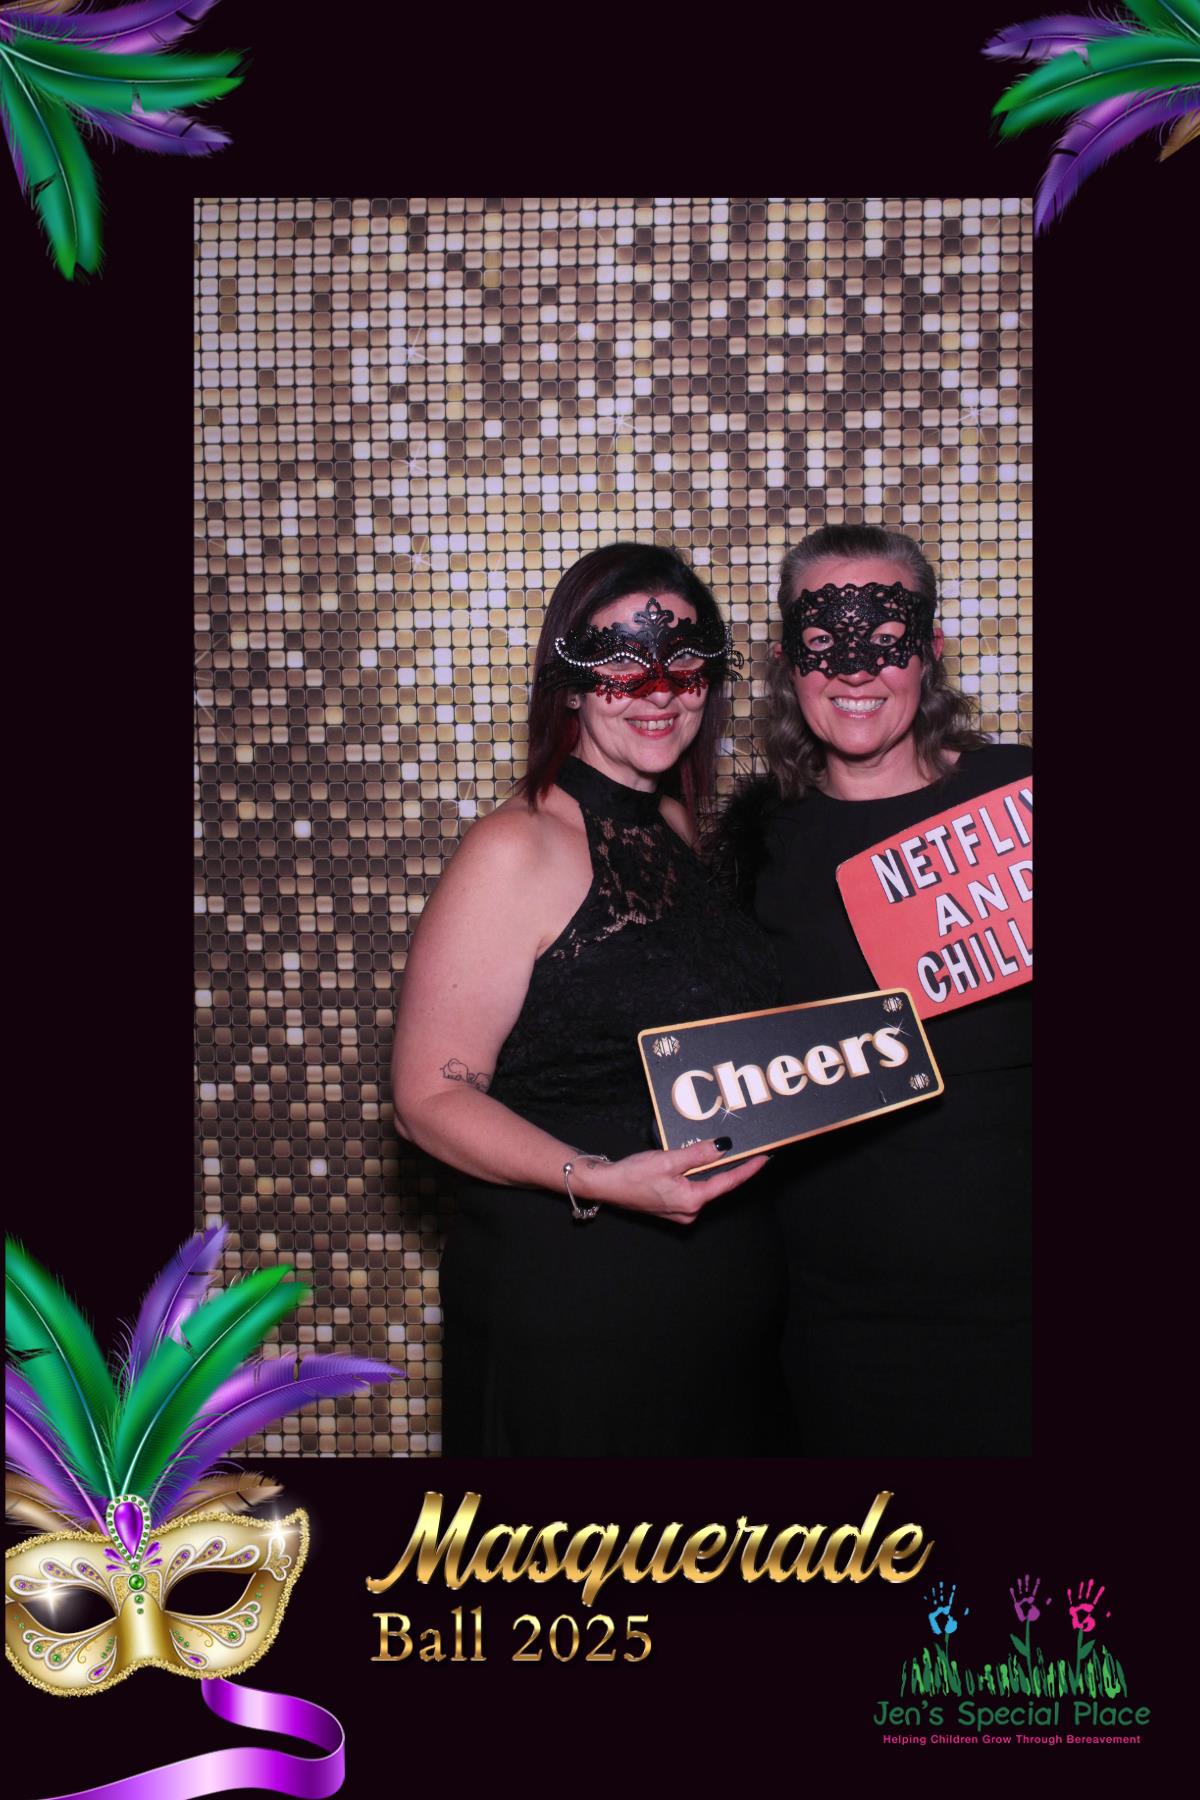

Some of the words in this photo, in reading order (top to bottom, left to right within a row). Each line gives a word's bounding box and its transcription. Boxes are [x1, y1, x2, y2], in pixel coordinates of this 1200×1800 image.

[870, 789, 1033, 904] NETFLI
[936, 861, 1033, 937] AND
[916, 919, 1033, 1003] CHILL
[671, 1026, 909, 1121] Cheers
